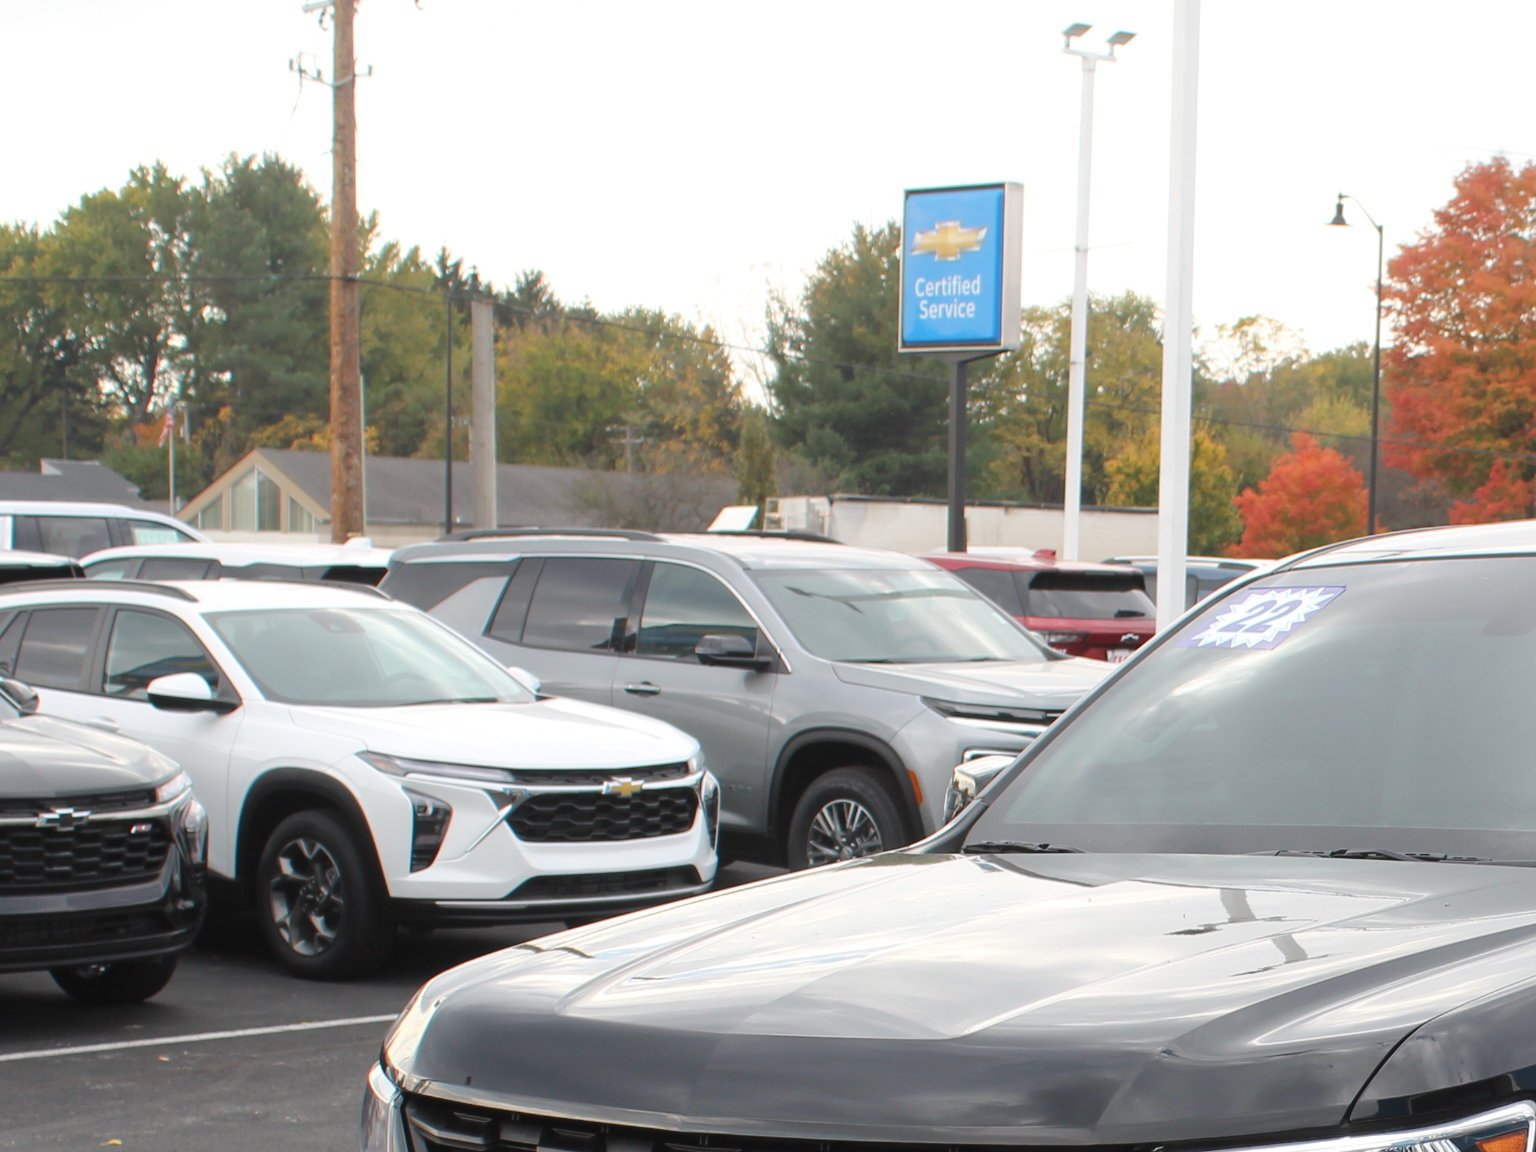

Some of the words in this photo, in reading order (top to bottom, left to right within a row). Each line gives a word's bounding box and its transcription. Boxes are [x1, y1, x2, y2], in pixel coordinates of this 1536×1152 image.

[914, 274, 981, 297] Certified
[919, 299, 976, 319] Service
[1215, 598, 1304, 633] 22
